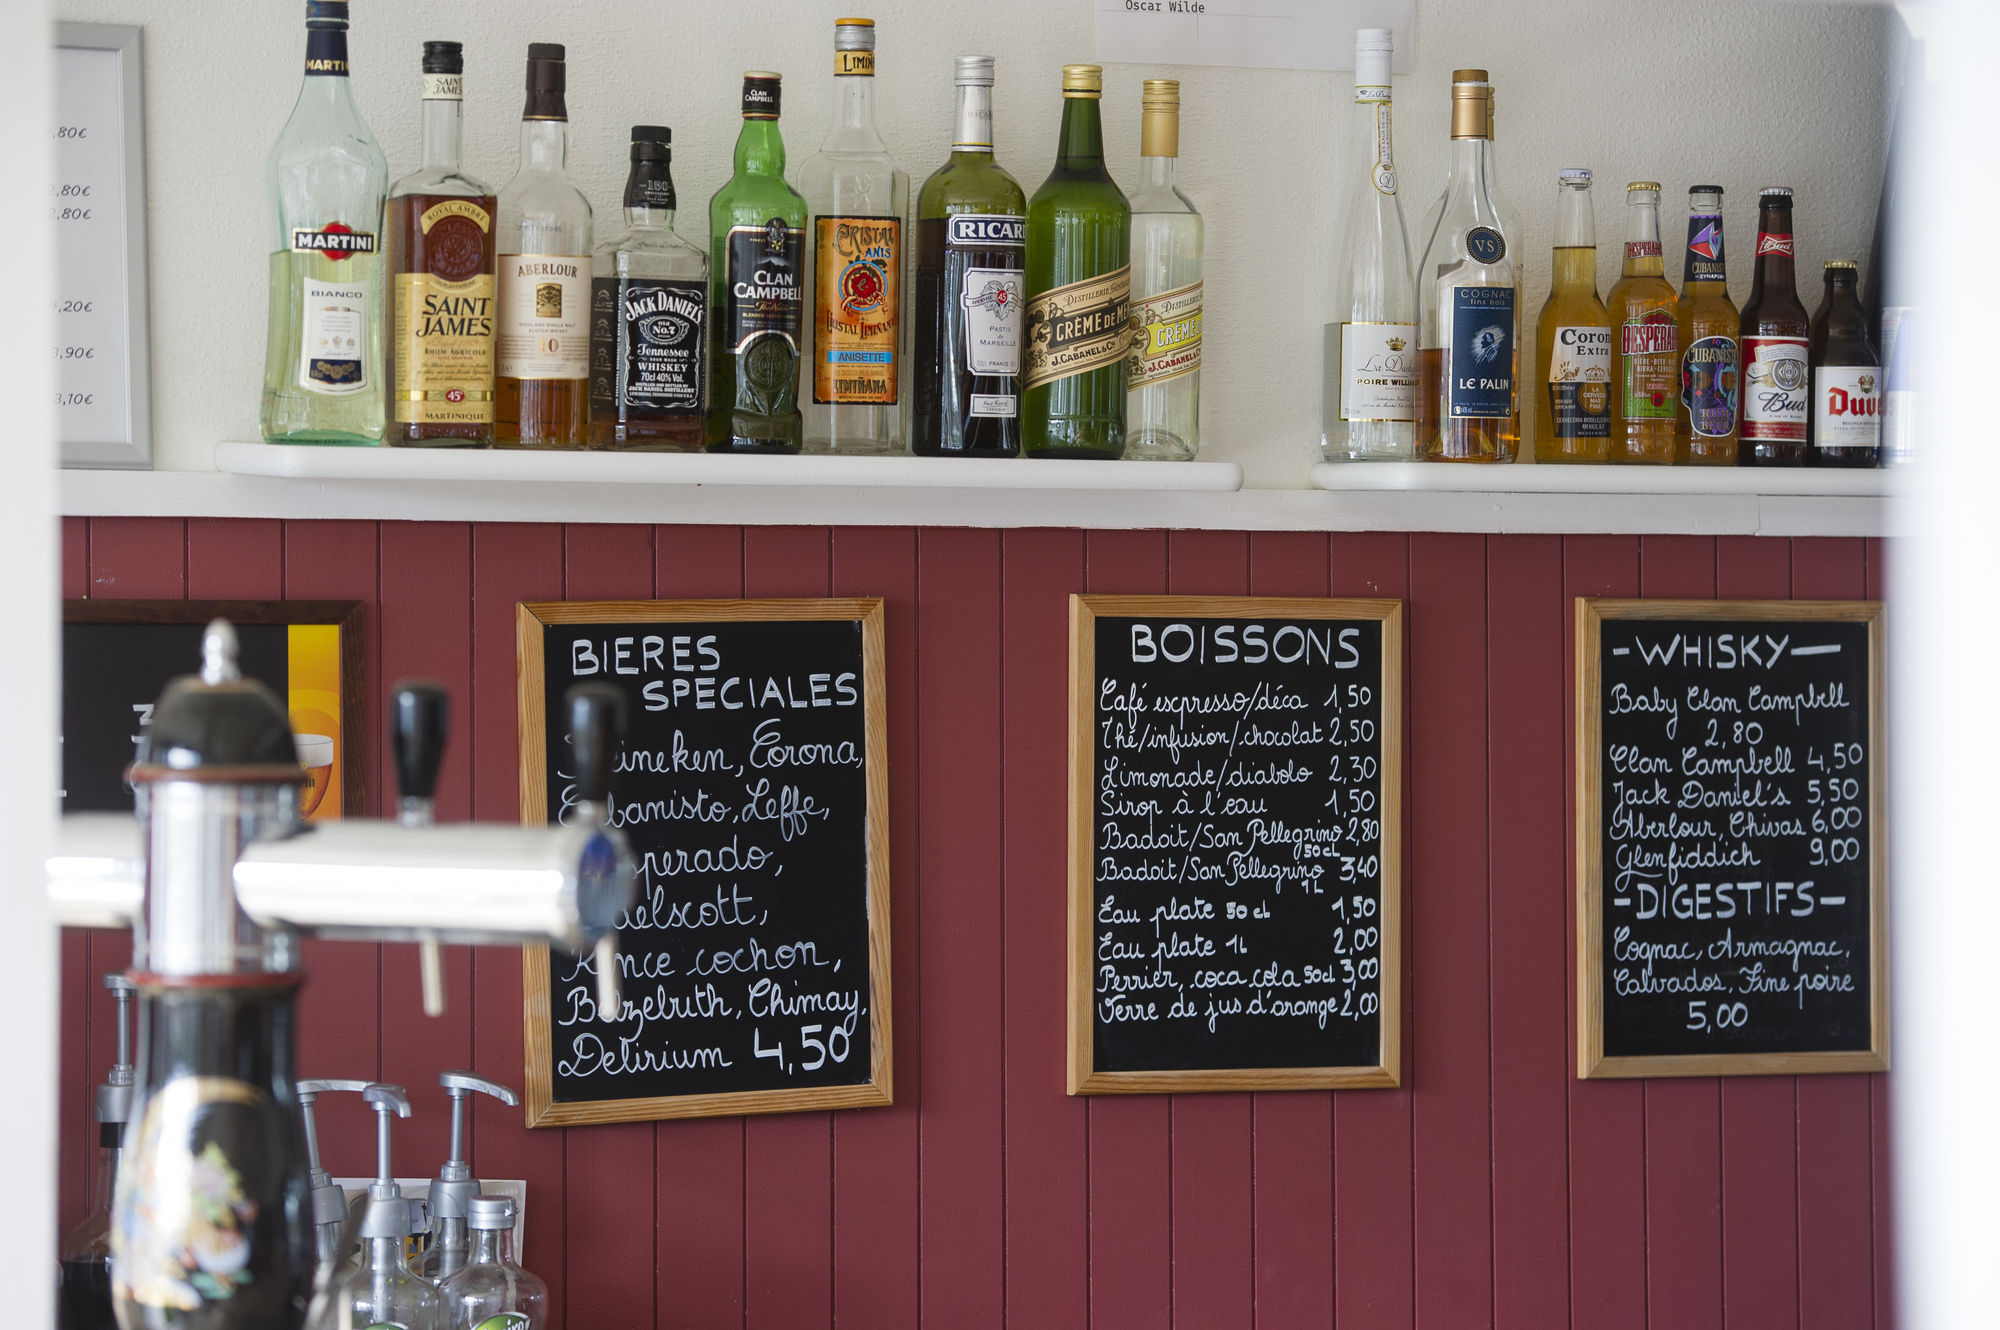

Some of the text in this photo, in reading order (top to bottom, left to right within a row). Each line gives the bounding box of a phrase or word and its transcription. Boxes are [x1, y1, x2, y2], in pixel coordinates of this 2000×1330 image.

[1125, 0, 1206, 14] Oscar Wilde
[744, 94, 773, 103] CAMPBELL
[51, 126, 87, 139] ,80€
[427, 205, 453, 222] ROYAL
[297, 233, 373, 250] MARTINI
[832, 223, 895, 257] CRISTAL
[958, 221, 1026, 239] RICAR
[864, 245, 892, 259] ANIS
[1761, 239, 1791, 250] Bud
[518, 263, 578, 278] ABERLOUR
[753, 269, 793, 286] CLAN
[311, 290, 363, 299] BIANCO
[733, 281, 802, 301] CAMPBELL
[997, 291, 1007, 302] 45
[1460, 289, 1512, 300] COGNAC
[422, 294, 491, 316] SAINT
[625, 291, 704, 324] JACK DANIEL'S
[415, 317, 492, 337] JAMES
[989, 325, 1012, 333] PASTIS
[1056, 302, 1129, 342] CRÈME DE ME
[1157, 318, 1196, 348] CRÈME
[540, 337, 559, 353] 10
[979, 339, 1016, 347] MARSEILLE
[1560, 328, 1611, 346] Coron
[637, 343, 689, 358] Tennessee
[837, 351, 886, 362] ANISETTE
[1576, 345, 1609, 356] Extra
[637, 362, 688, 372] WHISKEY
[641, 372, 684, 383] 70cl 40% Vol.
[1357, 378, 1389, 386] POIRE
[1459, 378, 1509, 390] LE PALIN
[1701, 408, 1730, 418] RUM
[1758, 391, 1807, 412] Bud
[425, 412, 484, 421] MARTINIQUE
[1701, 421, 1730, 431] BEER
[571, 634, 721, 676] BIERES
[1131, 623, 1360, 669] BOISSONS
[642, 672, 859, 711] SPECIALES
[1099, 677, 1148, 730] Café
[1323, 683, 1372, 714] 1,50
[1608, 682, 1850, 741] Baby Clan Campbell
[749, 718, 864, 769] Corona,
[1328, 716, 1375, 747] 2,50
[1704, 718, 1764, 750] 2,80
[1328, 754, 1377, 784] 2,30
[1609, 742, 1864, 798] Clan Campbell 4,50
[557, 777, 830, 842] Cbanisto, Leffe,
[1101, 789, 1163, 828] Sirop
[1171, 789, 1194, 815] à
[1324, 788, 1376, 818] 1,50
[1612, 777, 1860, 827] Jack Daniel's 5,50
[1609, 806, 1863, 842] Aberlour, Chivas 6,00
[1246, 817, 1343, 860] Pellegrino
[1345, 815, 1379, 847] 2,80
[1225, 850, 1325, 894] Pellegrino
[1338, 854, 1378, 885] 3,40
[1614, 837, 1861, 893] Glenfiddich 9,00
[1098, 895, 1141, 924] Eau
[1149, 896, 1215, 939] plate
[1226, 901, 1248, 919] 50
[1331, 895, 1377, 925] 1,50
[561, 937, 842, 983] Rnce cochon,
[1098, 931, 1146, 962] Eau
[1151, 931, 1216, 972] plate
[1332, 926, 1379, 956] 2,00
[1613, 925, 1850, 977] Cognac, Armagnac,
[1096, 964, 1185, 994] Perrier,
[1189, 968, 1248, 990] coca
[1248, 960, 1302, 989] cola
[1340, 957, 1379, 991] 3,00
[1613, 961, 1855, 1011] Calvados, Fine poire
[748, 977, 867, 1037] Chimay,
[1098, 988, 1379, 1034] Verre de jus d'orange 2,00
[1686, 1001, 1749, 1034] 5,00
[558, 1023, 851, 1077] Delirium 4,50
